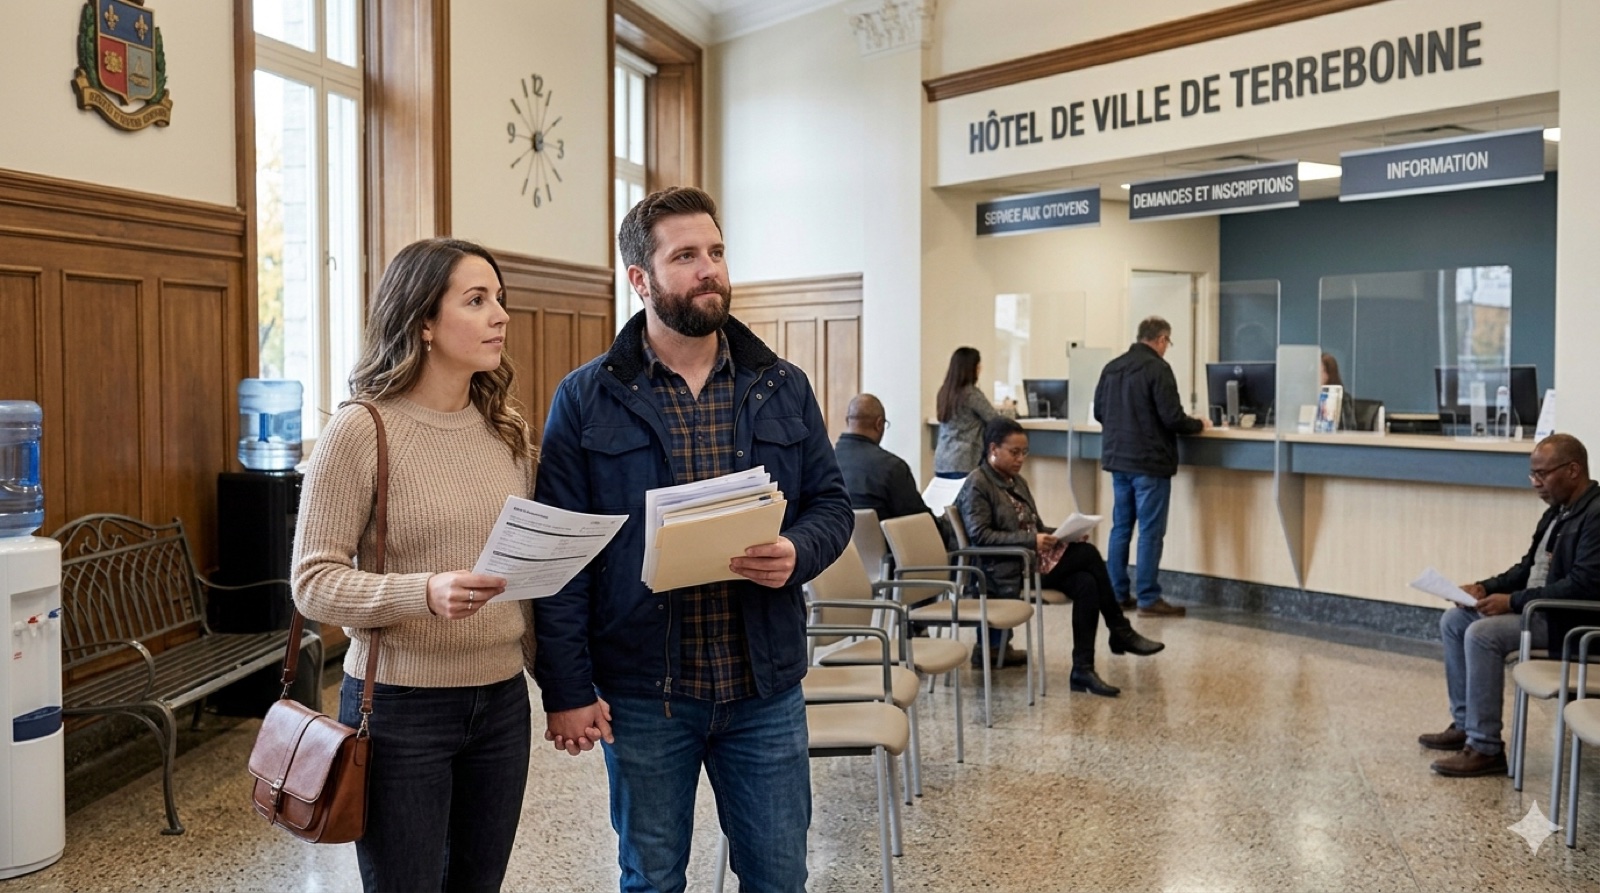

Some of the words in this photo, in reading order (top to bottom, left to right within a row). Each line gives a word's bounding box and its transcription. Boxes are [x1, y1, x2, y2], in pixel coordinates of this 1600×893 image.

[531, 74, 543, 98] 12
[969, 110, 1043, 154] HÔTEL
[1051, 101, 1085, 140] DE
[1092, 84, 1171, 132] VILLE
[1181, 73, 1221, 118] DE
[1229, 21, 1483, 108] TERREBONNE
[507, 122, 516, 143] 9
[557, 139, 564, 159] 3
[1387, 151, 1489, 180] INFORMATION
[533, 187, 541, 208] 6
[1133, 187, 1193, 209] DEMANDES
[1195, 185, 1210, 202] ET
[1212, 175, 1294, 200] INSCRIPTIONS
[1042, 200, 1090, 220] CITOYENS
